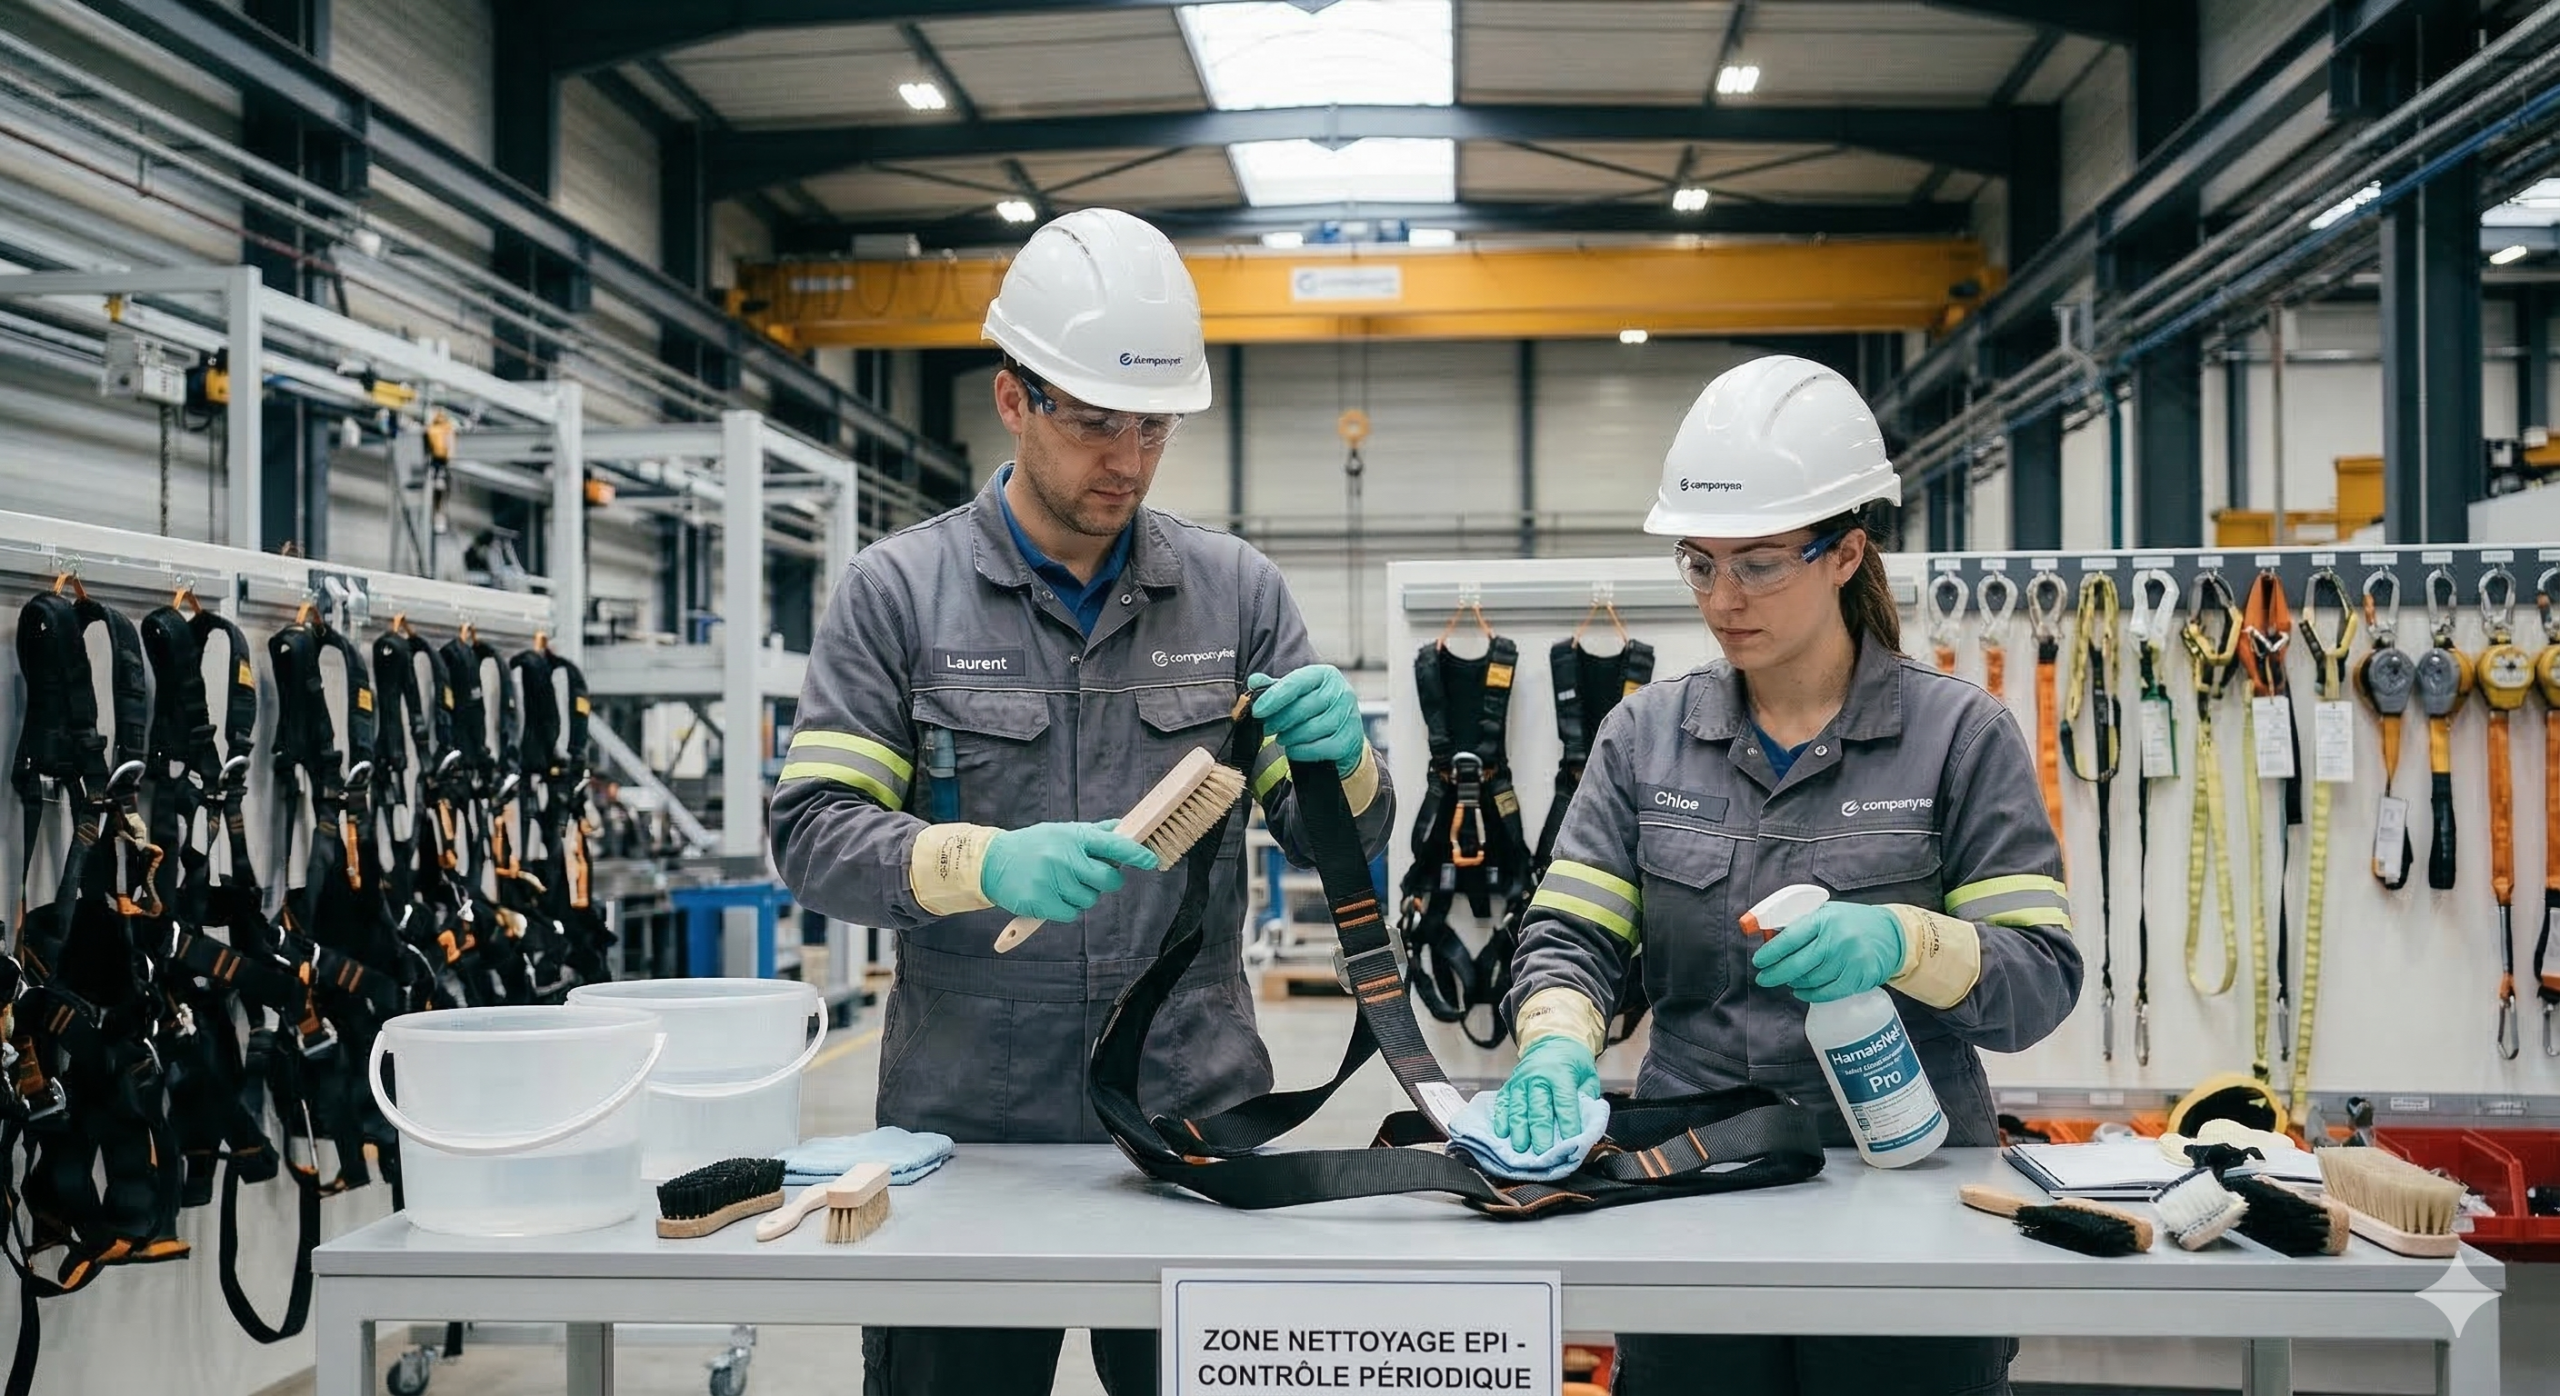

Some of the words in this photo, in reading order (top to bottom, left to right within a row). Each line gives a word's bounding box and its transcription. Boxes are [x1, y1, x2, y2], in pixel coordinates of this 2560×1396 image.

[946, 654, 1008, 670] Laurent
[1654, 791, 1700, 810] Chloe
[1868, 1070, 1902, 1093] Pro
[1203, 1329, 1279, 1351] ZONE
[1289, 1330, 1455, 1352] NETTOYAGE
[1465, 1332, 1507, 1353] EPI
[1198, 1359, 1350, 1387] CONTRÔLE
[1359, 1360, 1532, 1390] PÉRIODIQUE
